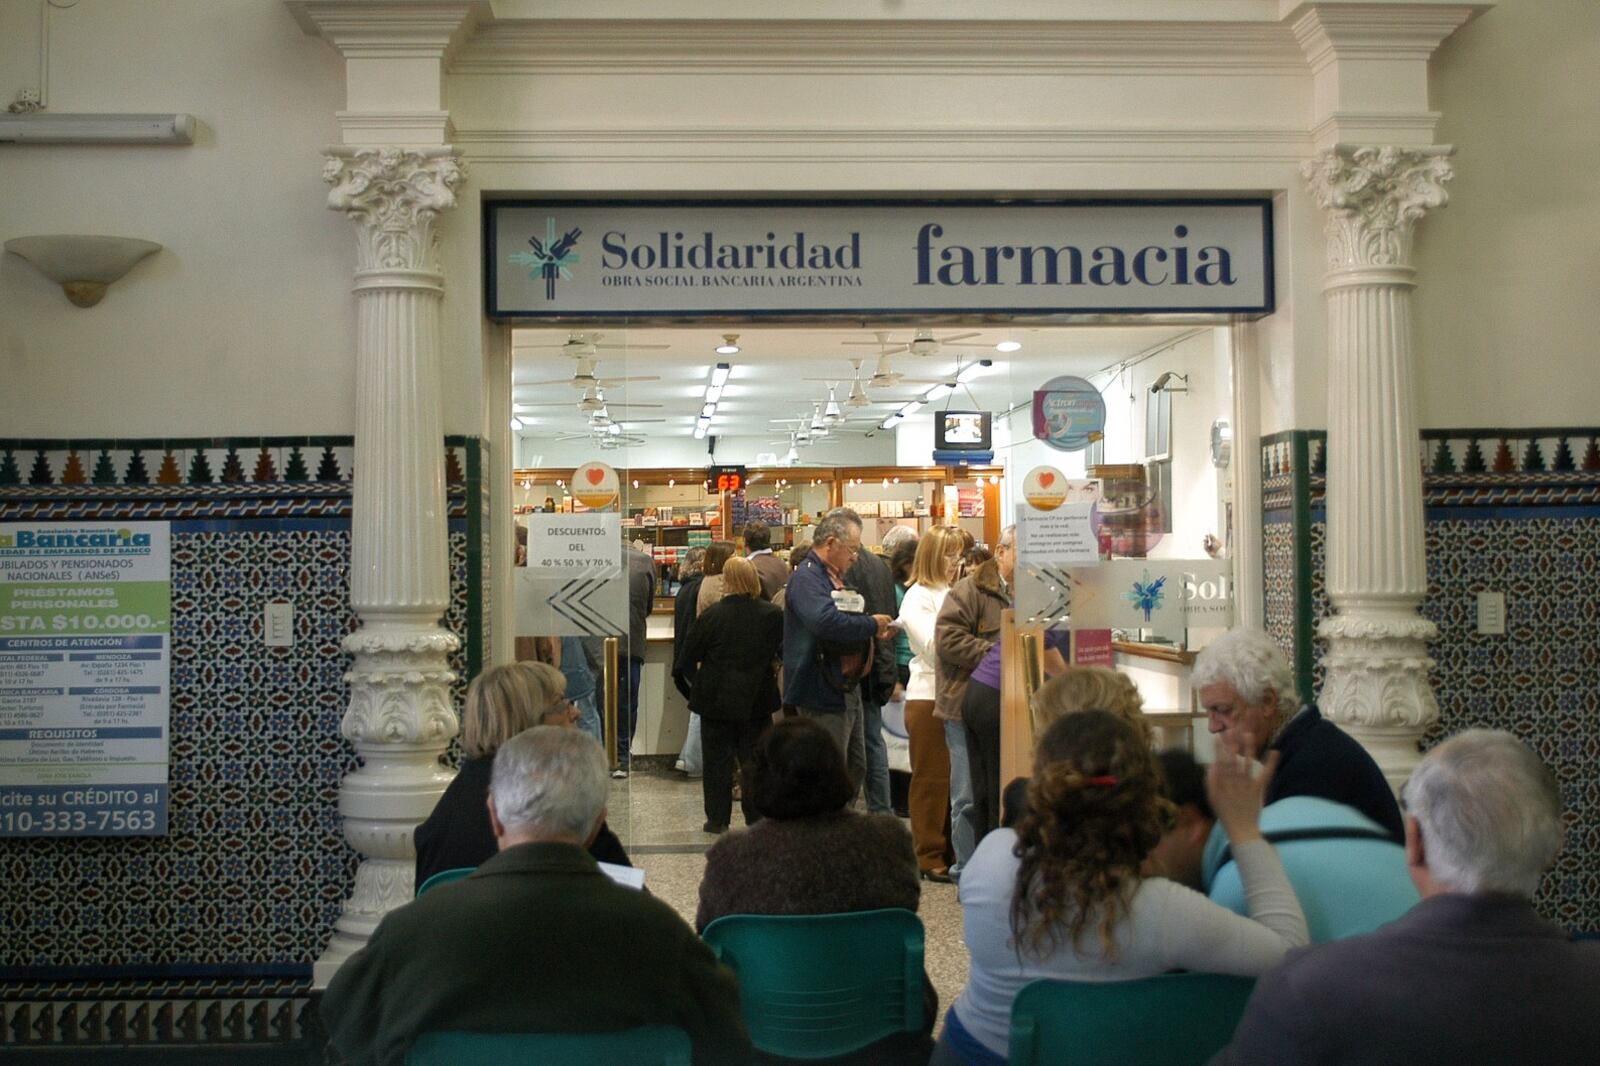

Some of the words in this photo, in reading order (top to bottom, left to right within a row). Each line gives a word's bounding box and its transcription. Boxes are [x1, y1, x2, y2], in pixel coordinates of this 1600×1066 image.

[601, 231, 862, 270] Solidaridad
[912, 223, 1238, 286] farmacia
[602, 276, 641, 287] OBRA
[645, 276, 698, 287] SOCIAL
[702, 275, 775, 287] BANCARIA
[777, 275, 862, 287] ARGENTINA
[718, 474, 740, 491] 63
[547, 527, 606, 536] DESCUENTOS
[16, 528, 151, 548] Bancaria
[569, 543, 585, 552] DEL
[51, 560, 59, 569] Y
[61, 559, 134, 569] PENSIONADOS
[541, 558, 552, 567] 40
[553, 558, 562, 567] %
[563, 558, 574, 567] 50
[575, 558, 584, 567] %
[585, 558, 591, 567] Y
[593, 558, 603, 567] 70
[605, 558, 613, 567] %
[7, 571, 73, 581] NACIONALES
[11, 599, 119, 609] PERSONALES
[8, 638, 53, 648] CENTROS
[55, 638, 69, 647] DE
[70, 636, 123, 647] ATENCIÓN
[28, 729, 98, 739] REQUISITOS
[37, 794, 57, 806] su
[62, 787, 138, 805] CRÉDITO
[143, 788, 158, 804] al
[0, 810, 156, 832] 10-333-7563
